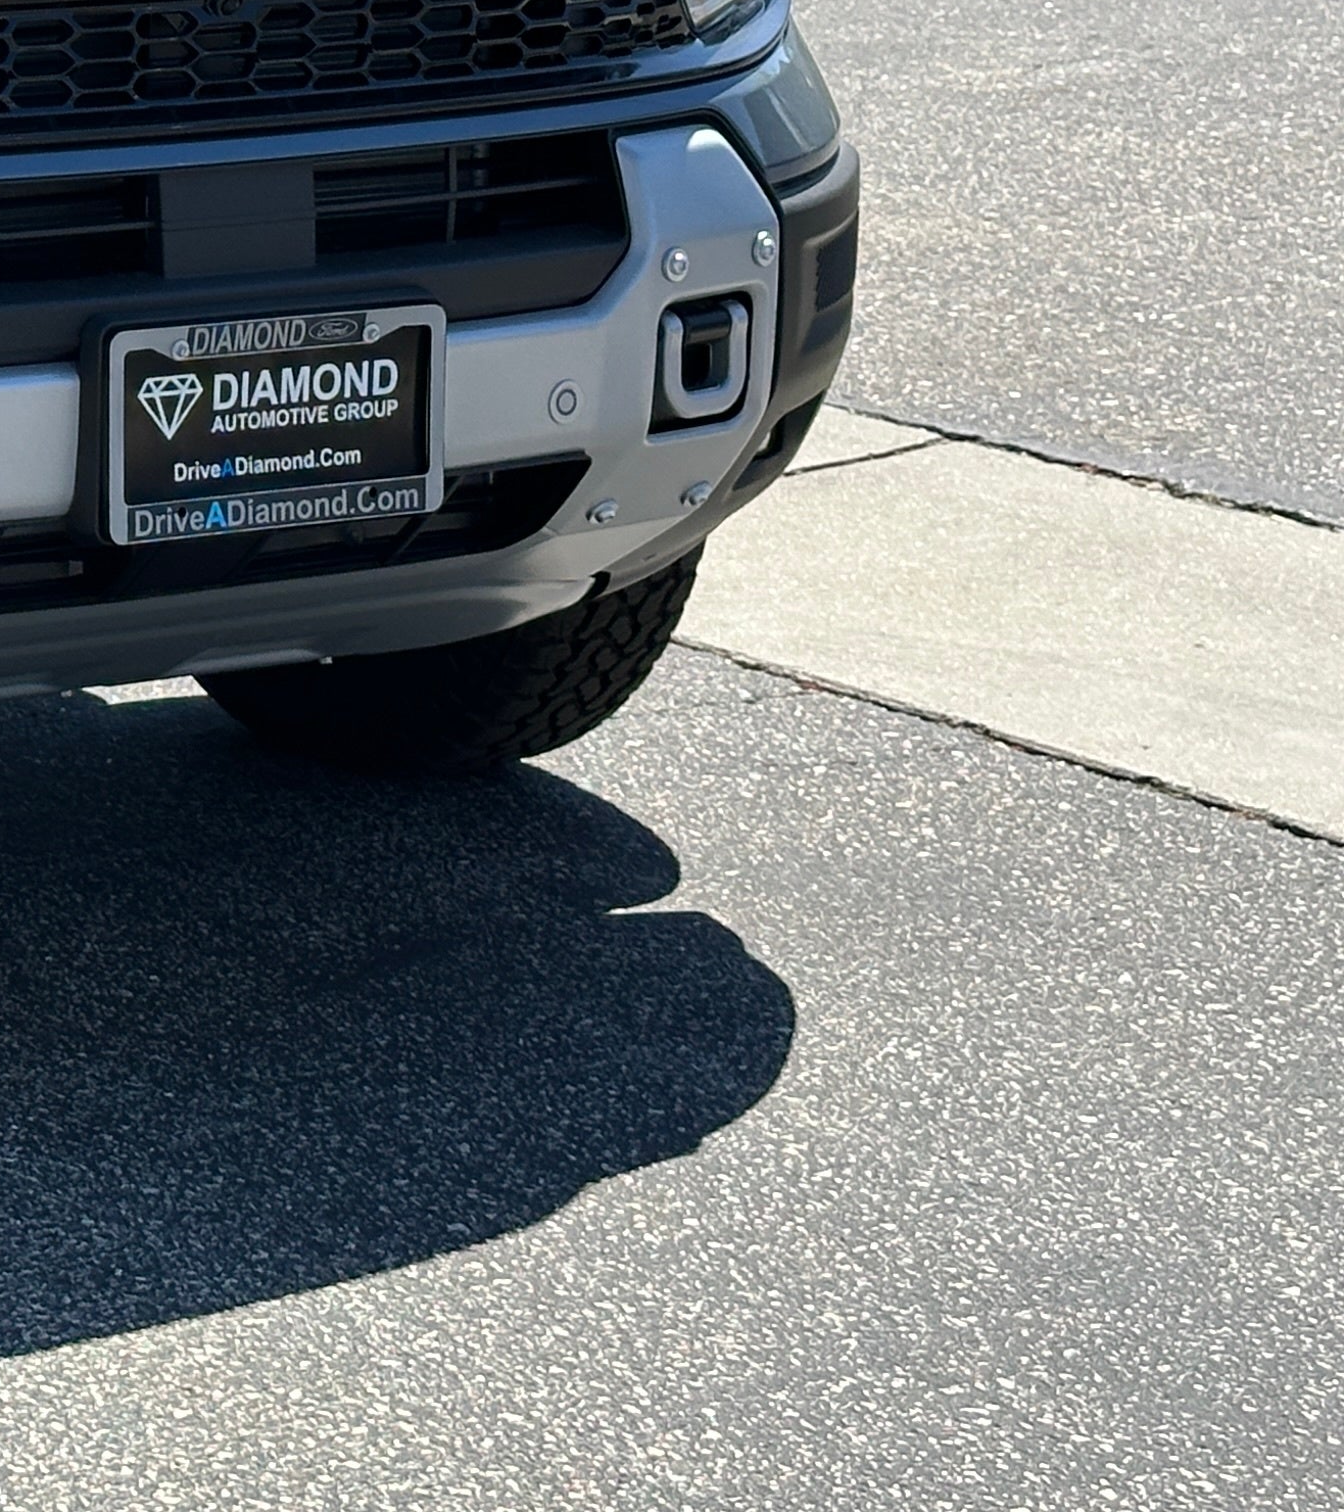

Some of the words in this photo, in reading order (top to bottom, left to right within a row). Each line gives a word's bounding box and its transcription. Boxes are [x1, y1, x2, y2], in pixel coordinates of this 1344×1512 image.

[190, 319, 307, 356] DIAMOND
[212, 358, 399, 411] DIAMOND
[211, 405, 329, 433] AUTOMOTIVE
[334, 399, 399, 422] GROUP
[173, 447, 362, 482] DriveADiamond.Com
[134, 486, 420, 538] DriveADiamond.Com
